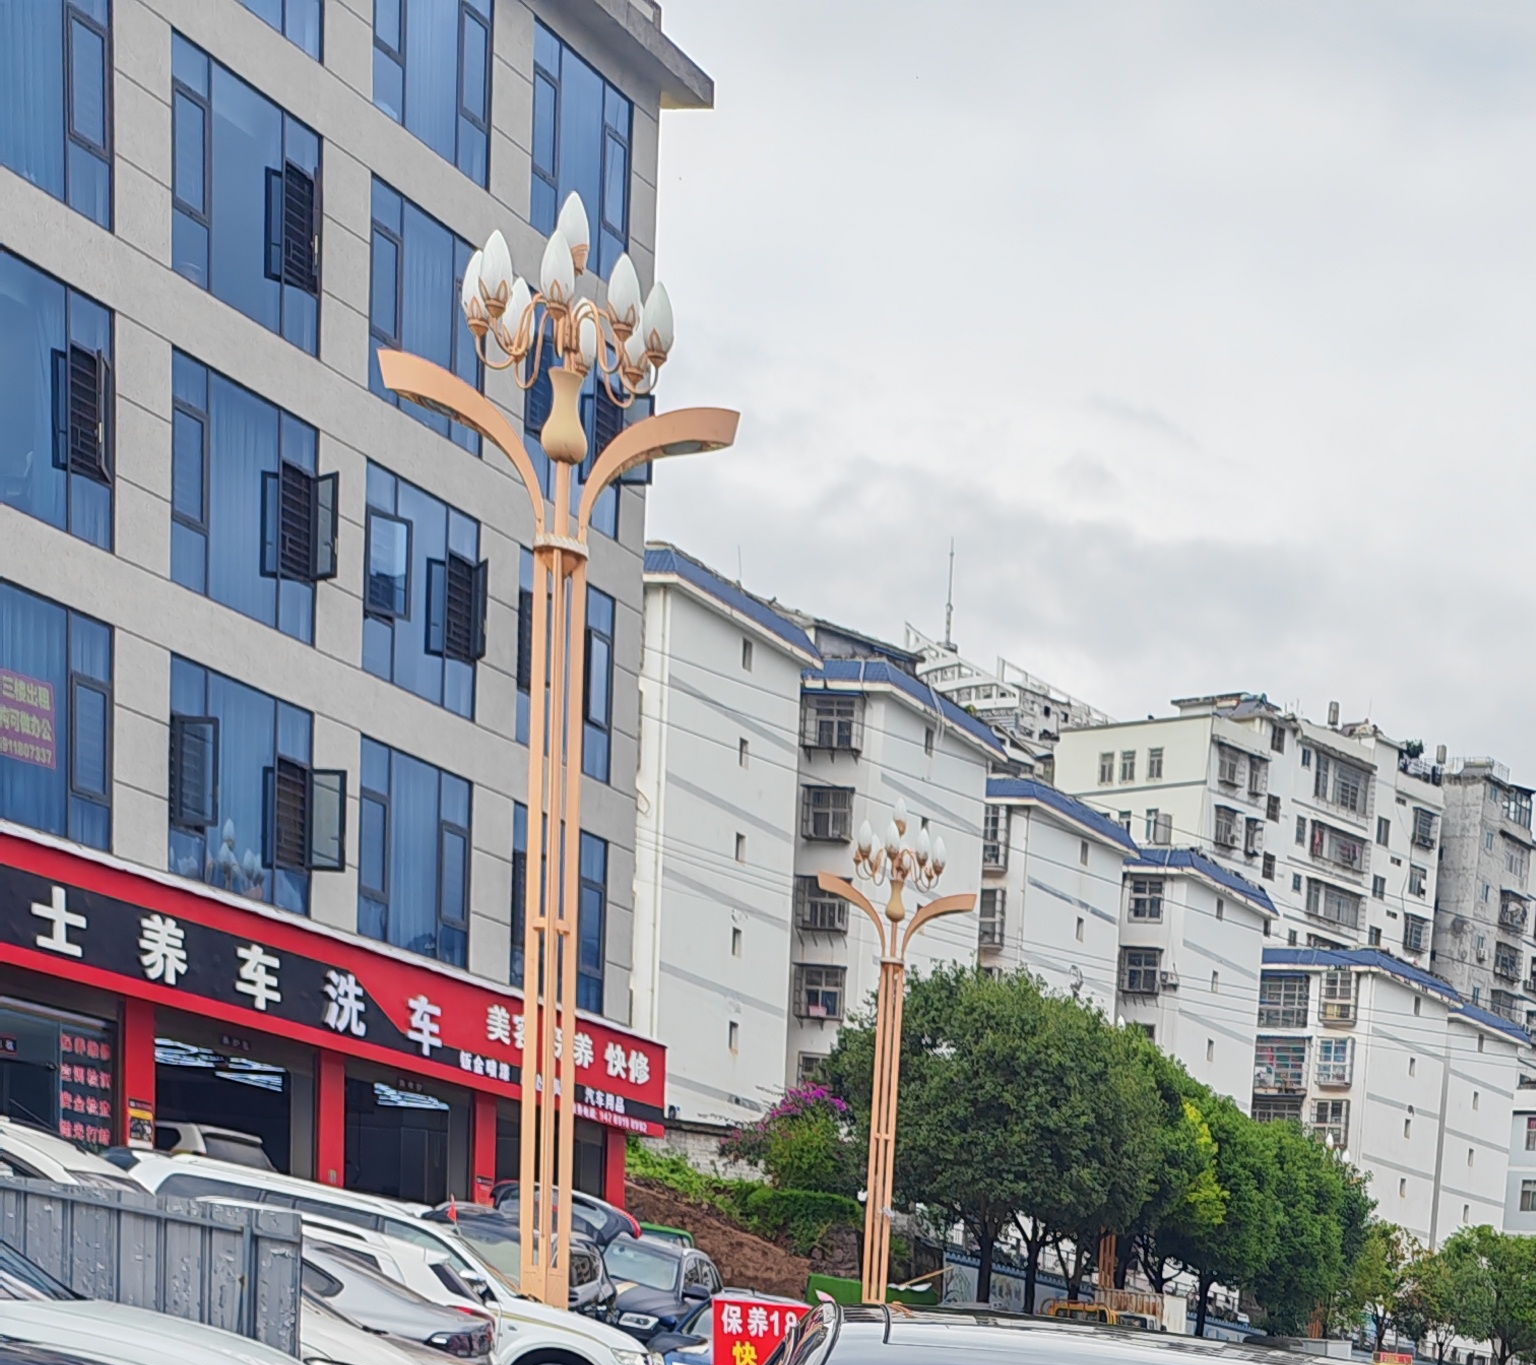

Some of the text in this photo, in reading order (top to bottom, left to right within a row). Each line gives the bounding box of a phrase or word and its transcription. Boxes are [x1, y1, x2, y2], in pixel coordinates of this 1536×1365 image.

[604, 1042, 650, 1085] 快修
[584, 1086, 625, 1114] 汽车用品
